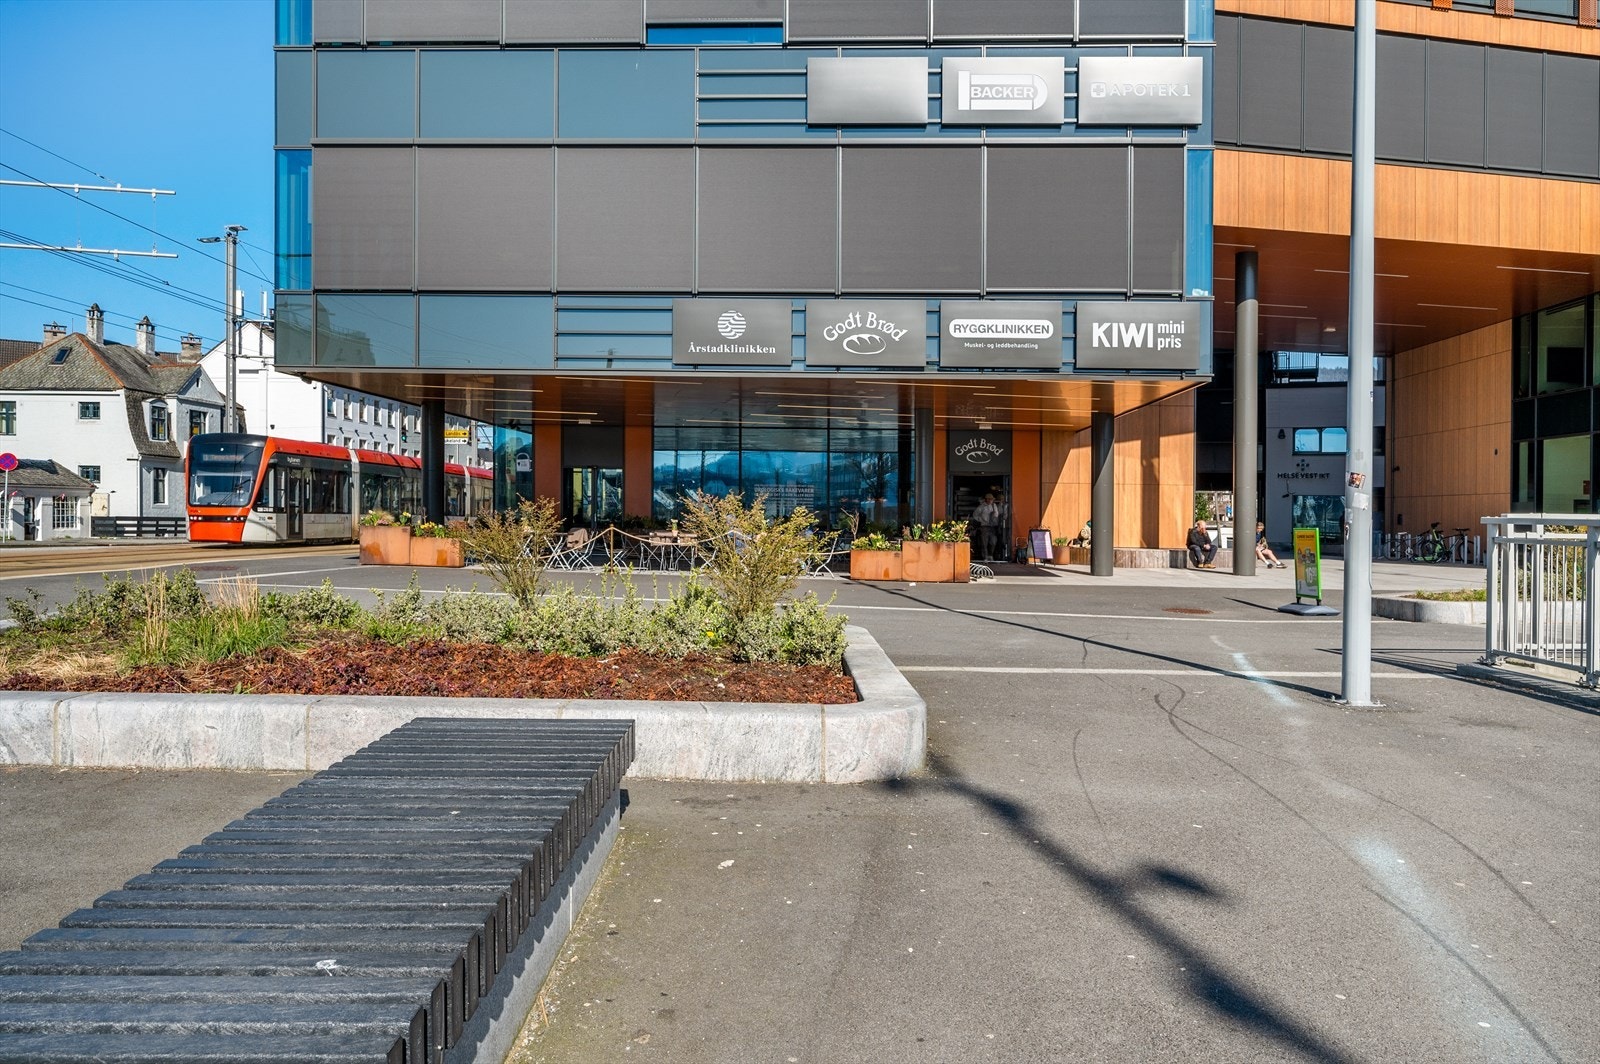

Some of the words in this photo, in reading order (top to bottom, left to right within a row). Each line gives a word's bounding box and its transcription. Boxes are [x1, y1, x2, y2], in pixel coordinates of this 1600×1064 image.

[971, 86, 1034, 98] BACKER
[1109, 84, 1179, 97] APOTEK
[1181, 84, 1191, 97] 1
[823, 312, 862, 342] Godt
[866, 311, 908, 342] Brød
[953, 323, 1050, 335] RYGGKLINIKKEN
[1157, 320, 1185, 333] mini
[1092, 322, 1154, 349] KIWI
[688, 341, 776, 354] Årstadklinikken
[995, 342, 1038, 350] leddbehandling
[1157, 336, 1181, 350] pris
[955, 439, 977, 456] Godt
[980, 439, 1004, 456] Brød
